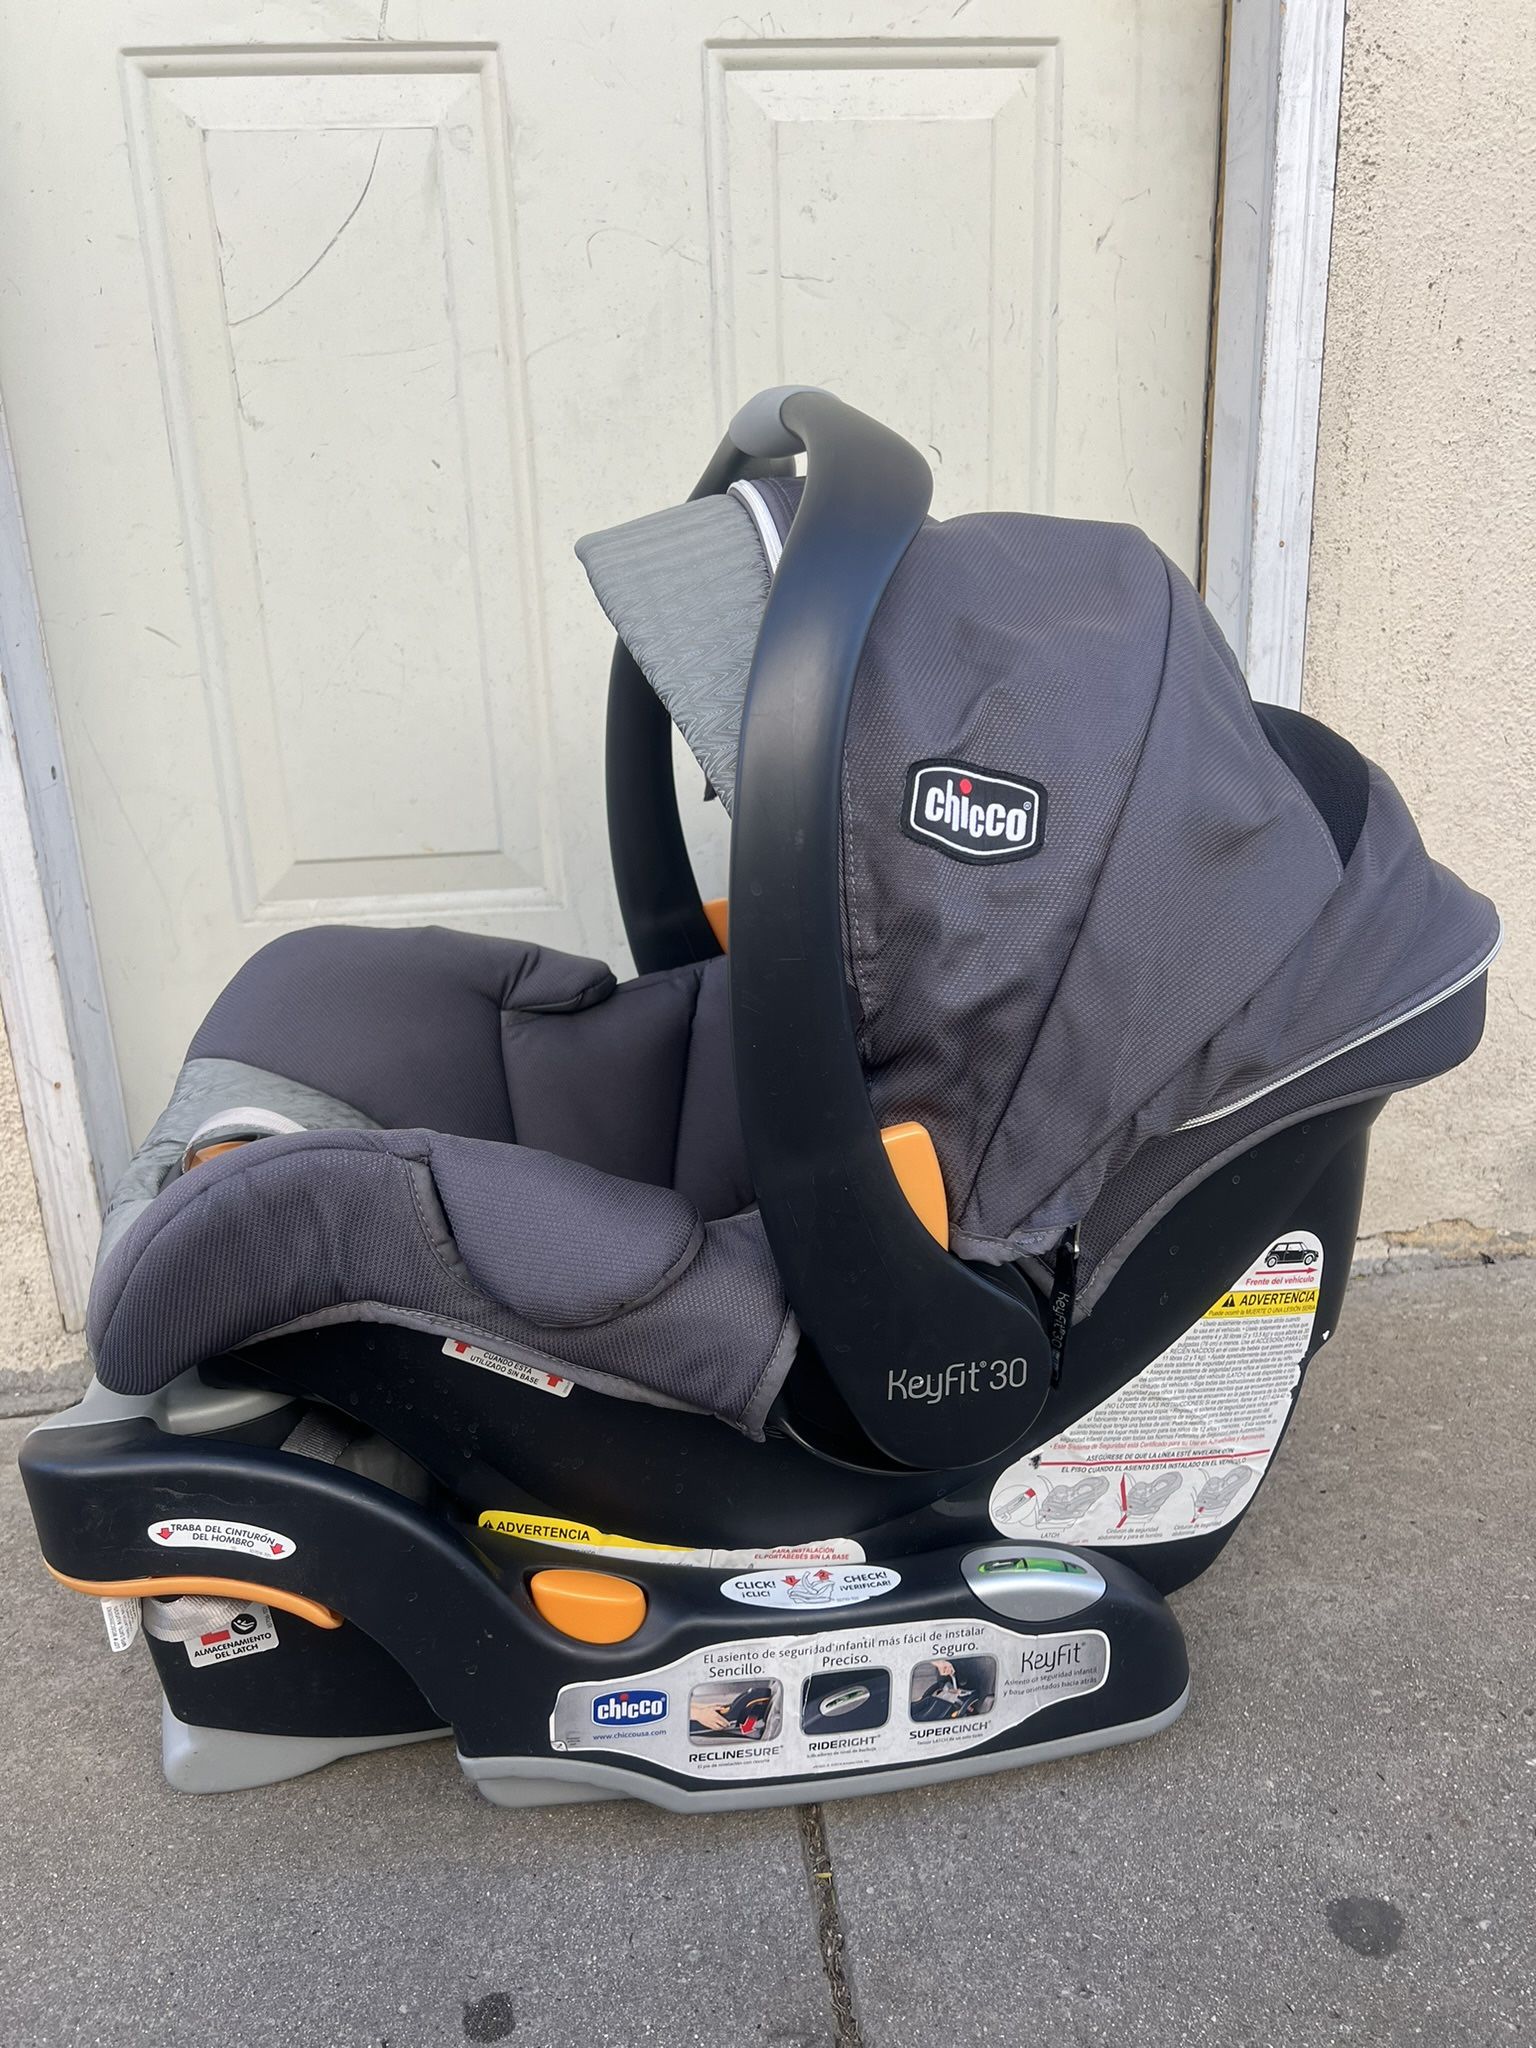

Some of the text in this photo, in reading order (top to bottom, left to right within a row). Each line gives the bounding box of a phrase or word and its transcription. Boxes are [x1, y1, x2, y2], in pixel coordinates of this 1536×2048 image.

[925, 778, 1028, 841] chicco
[1245, 1275, 1315, 1286] Frente del vehículo
[1239, 1291, 1315, 1306] ADVERTENCIA
[483, 1352, 513, 1367] CUANDO
[470, 1355, 539, 1385] UTILIZADO SIN BASE
[888, 1361, 980, 1404] KeyFit
[989, 1358, 1028, 1390] 30
[1134, 1452, 1147, 1460] QUE
[1123, 1464, 1150, 1472] ASIENTO
[1151, 1462, 1167, 1470] ESTÁ
[1168, 1461, 1201, 1469] INSTALADO
[170, 1524, 276, 1545] TRABA DEL CINTURÓN
[496, 1521, 590, 1541] ADVERTENCIA
[192, 1533, 255, 1548] DEL HOMBRO
[735, 1581, 776, 1590] CLICK!
[843, 1571, 888, 1584] CHECK!
[742, 1590, 771, 1598] ¡CLIC!
[840, 1580, 892, 1592] ¡VERIFICAR!
[194, 1632, 272, 1657] ALMACENAMIENTO
[215, 1643, 259, 1660] DEL LATCH
[704, 1627, 985, 1664] El asiento de seguridad infantil más fácil de instalar
[709, 1642, 979, 1679] Sencillo. Preciso. Seguro.
[1021, 1642, 1082, 1673] KeyFit
[1040, 1671, 1073, 1682] seguridad
[1073, 1666, 1097, 1675] infantil
[597, 1693, 663, 1719] chicco
[593, 1729, 667, 1741] www.chiccousa.com
[909, 1721, 988, 1740] SUPERCINCH
[808, 1736, 877, 1751] RIDERIGHT
[689, 1746, 780, 1762] RECLINESURE
